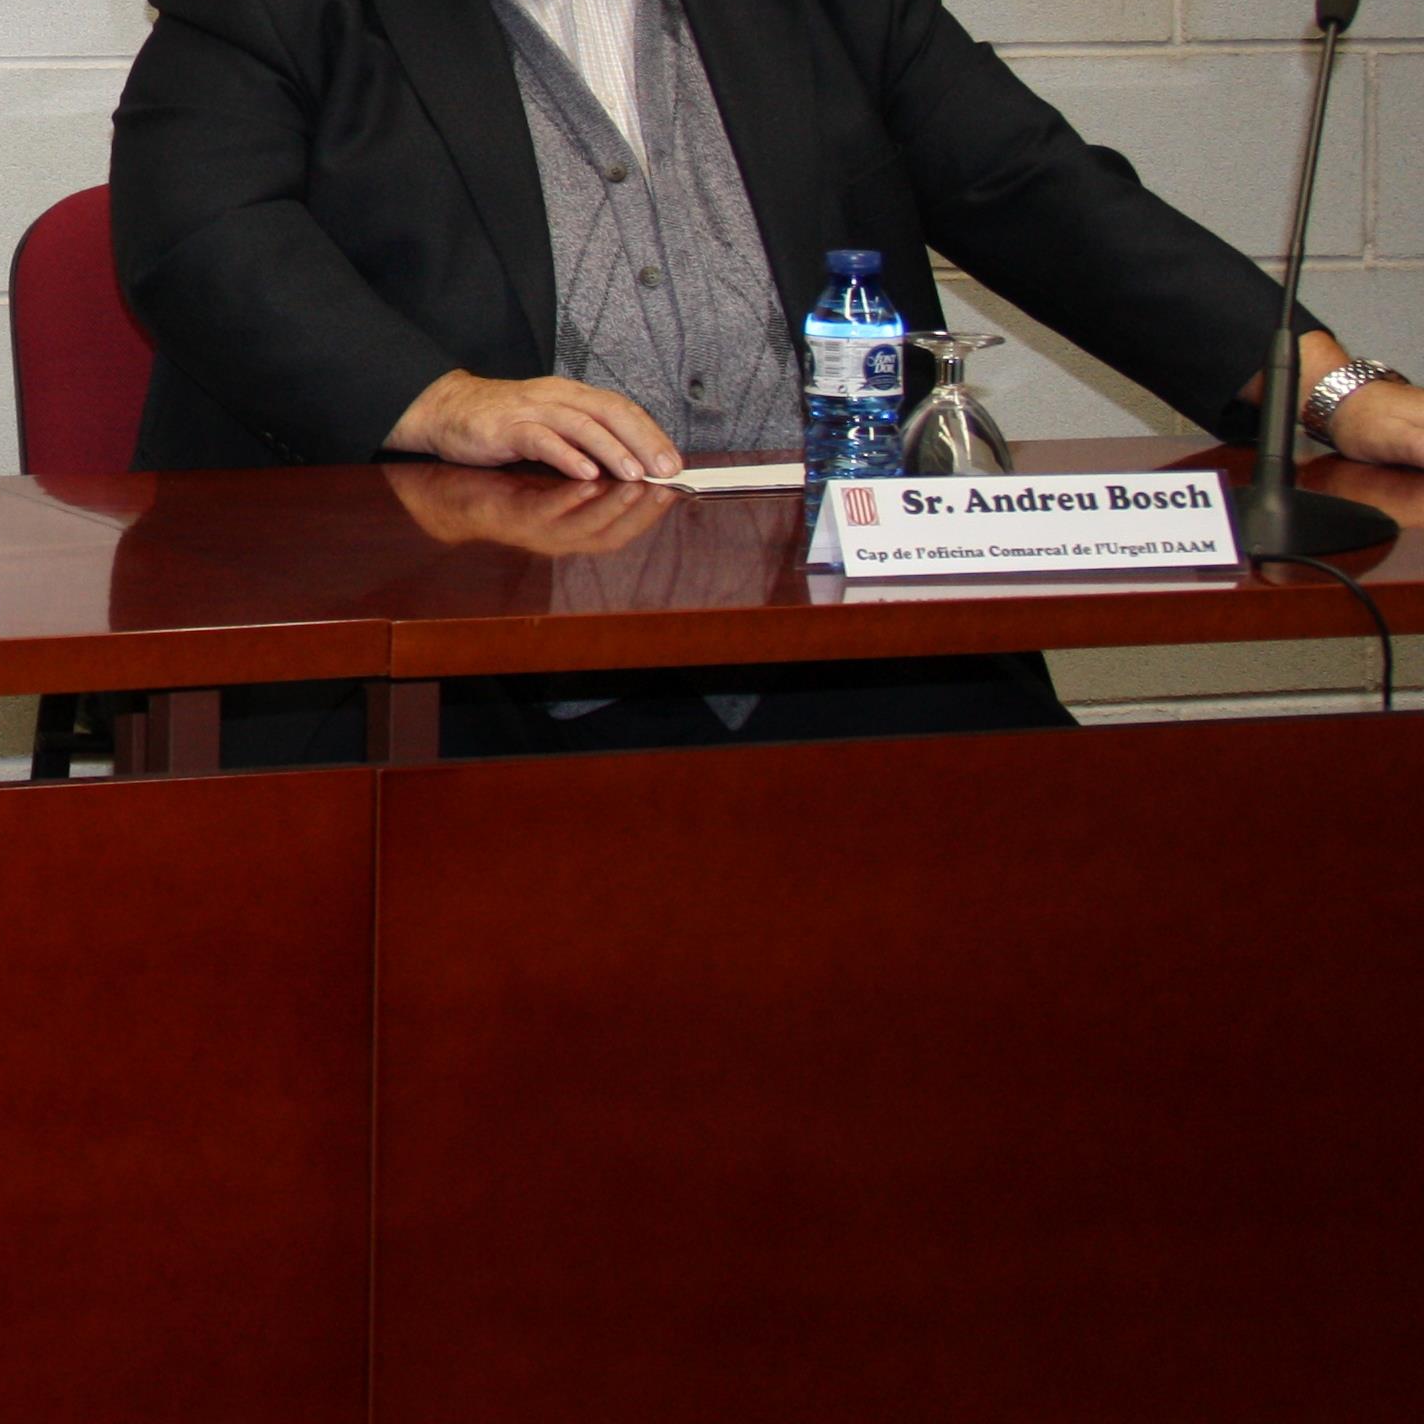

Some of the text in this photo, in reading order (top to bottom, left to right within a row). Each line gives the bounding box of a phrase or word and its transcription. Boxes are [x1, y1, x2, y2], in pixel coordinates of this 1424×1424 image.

[902, 484, 1212, 515] Sr. Andreu Bosch
[856, 548, 889, 563] Cap
[892, 548, 912, 560] de
[988, 545, 1069, 558] Comarcal
[1073, 543, 1092, 555] de
[1161, 540, 1217, 554] DAAM
